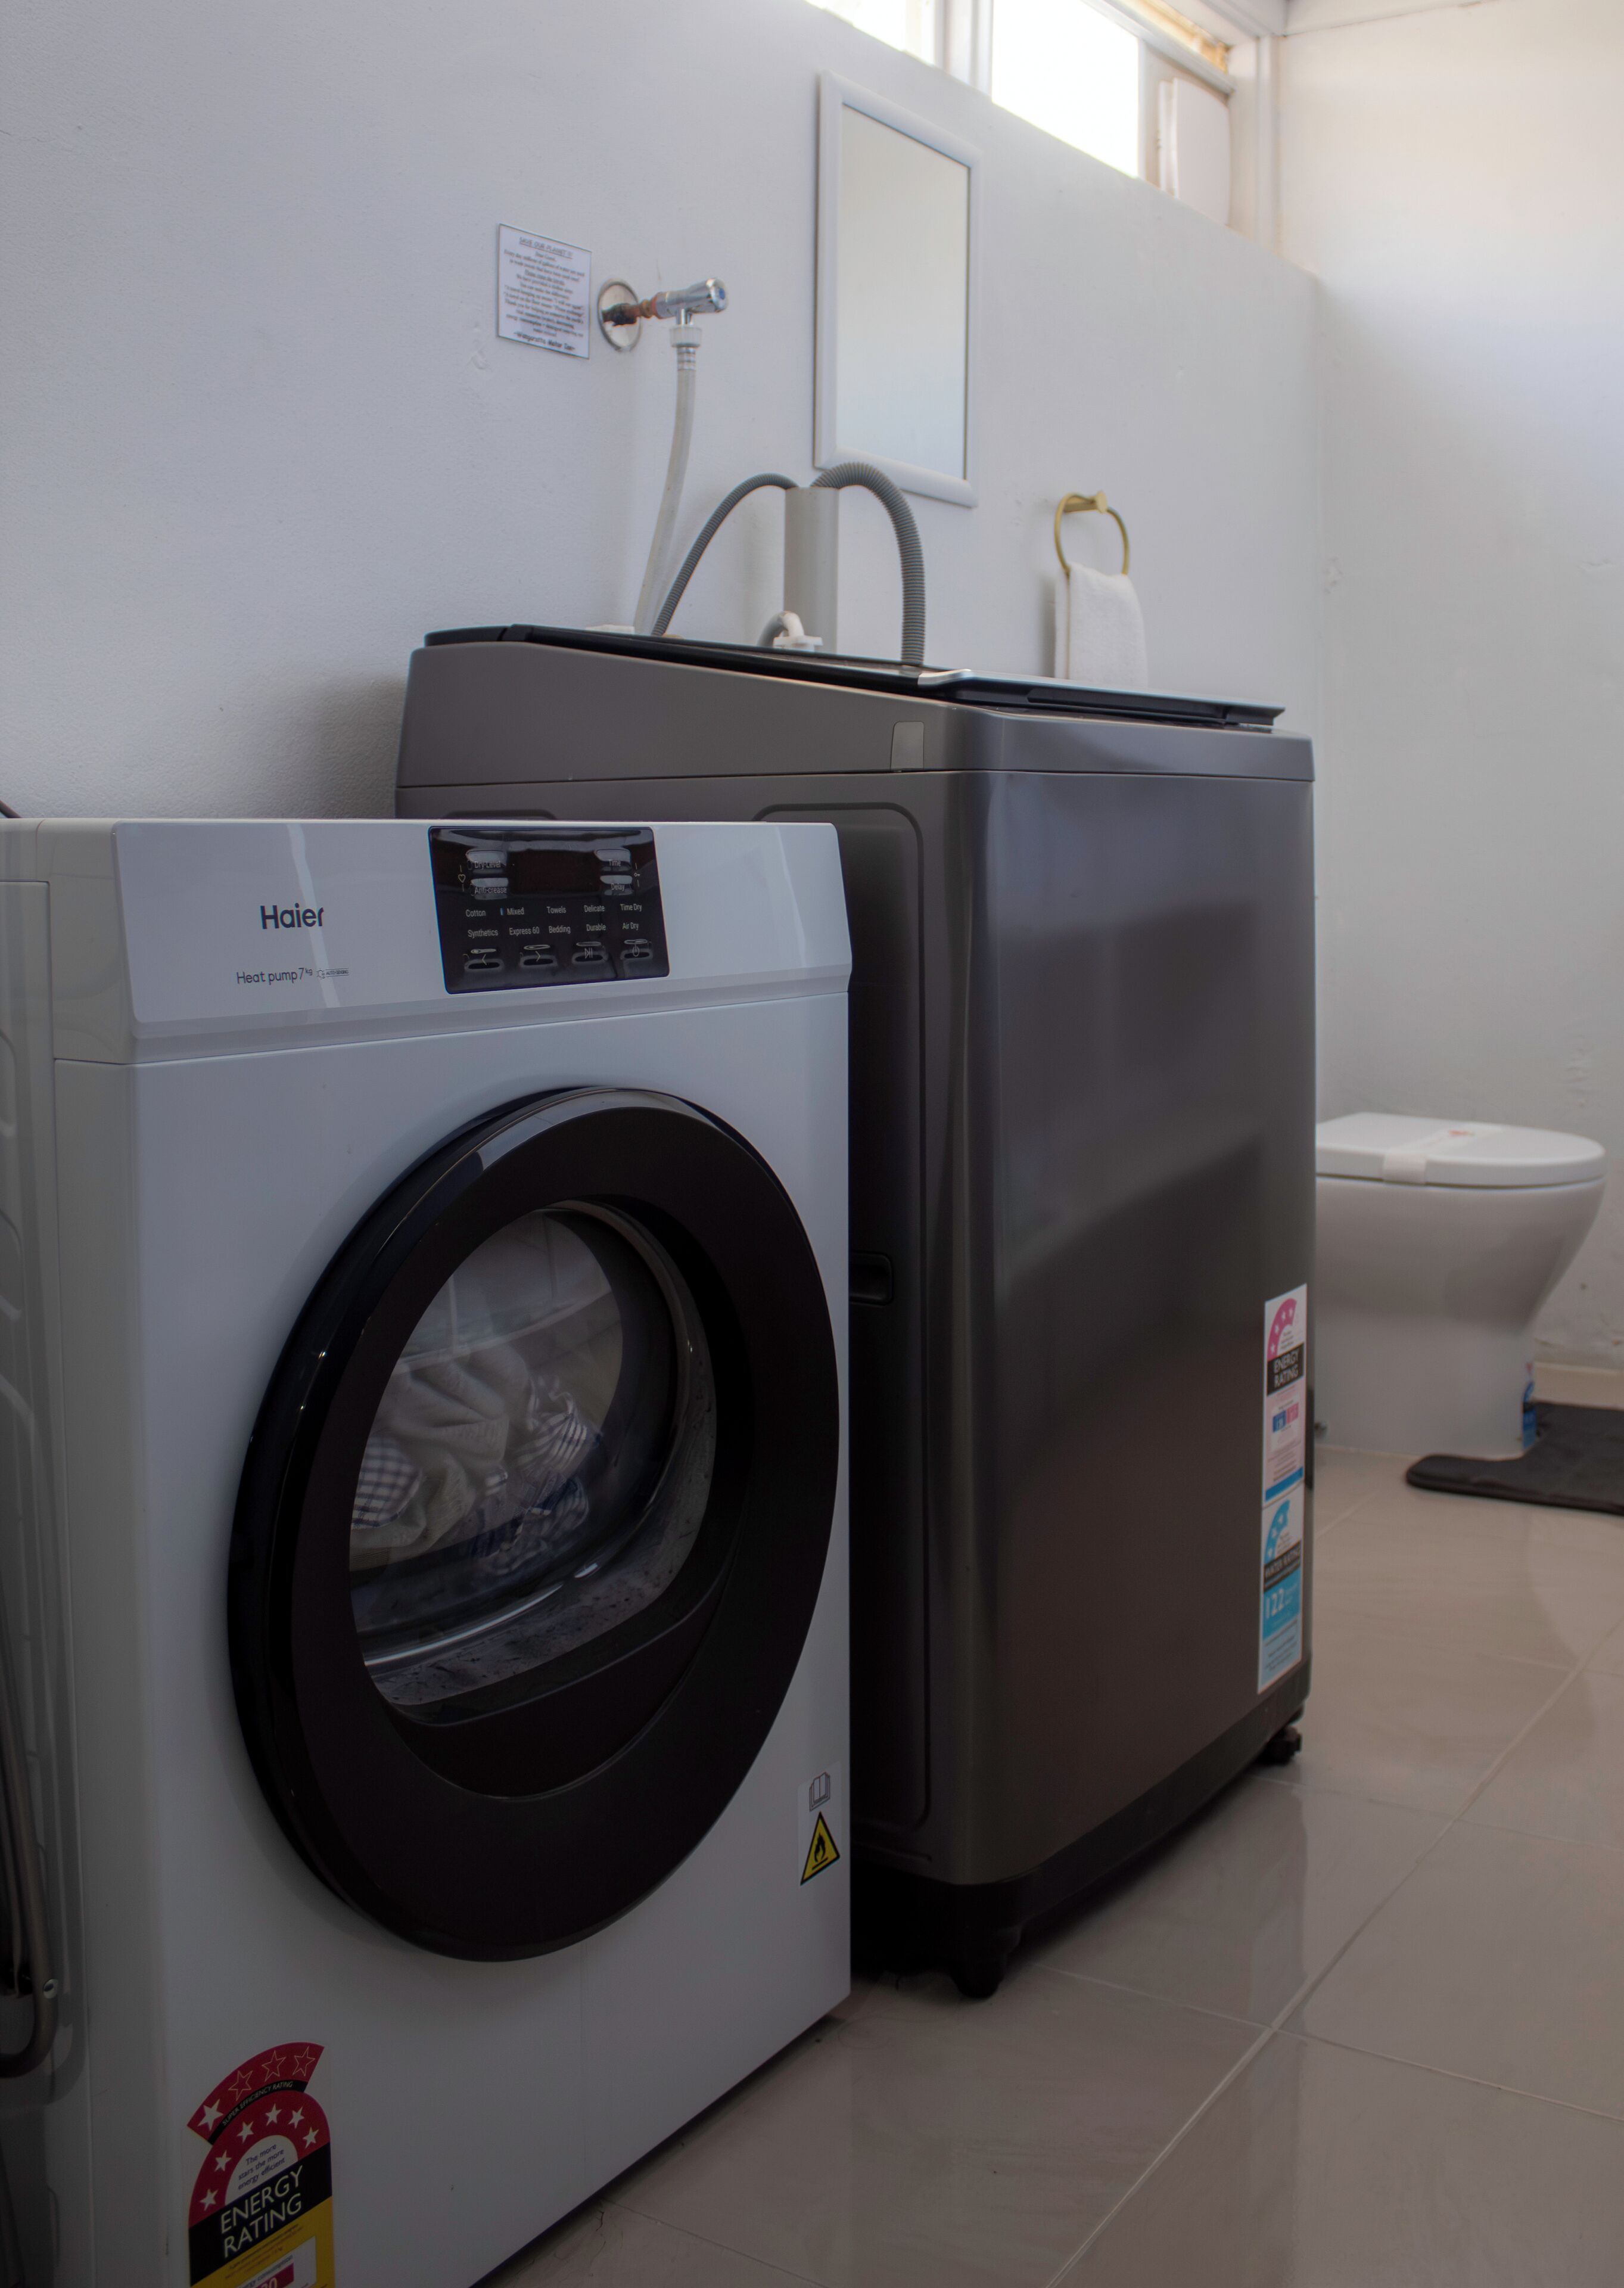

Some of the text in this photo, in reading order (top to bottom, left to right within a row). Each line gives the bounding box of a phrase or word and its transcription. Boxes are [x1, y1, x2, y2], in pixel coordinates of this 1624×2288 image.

[474, 860, 501, 869] Dry-Level
[474, 885, 507, 894] Anti-crease
[611, 883, 625, 891] Delay
[465, 909, 486, 917] Cotton
[506, 907, 525, 916] Mixed
[546, 906, 567, 914] Towels
[633, 903, 642, 912] Dry
[260, 903, 324, 930] Haier
[509, 926, 540, 936] Express 60
[548, 925, 571, 934] Bedding
[630, 922, 639, 931] Dry
[468, 929, 499, 939] Synthetics
[237, 971, 266, 984] Heat
[268, 972, 297, 985] pump
[1274, 1351, 1299, 1373] ENERGY
[1274, 1364, 1299, 1388] RATING
[1265, 1588, 1284, 1619] 122
[222, 2081, 293, 2126] SUPER EFFICIENCY RATING
[245, 2144, 276, 2165] The more
[239, 2149, 284, 2180] stars the more
[238, 2158, 285, 2190] energy efficient
[220, 2165, 303, 2234] ENERGY
[224, 2193, 302, 2259] RATING
